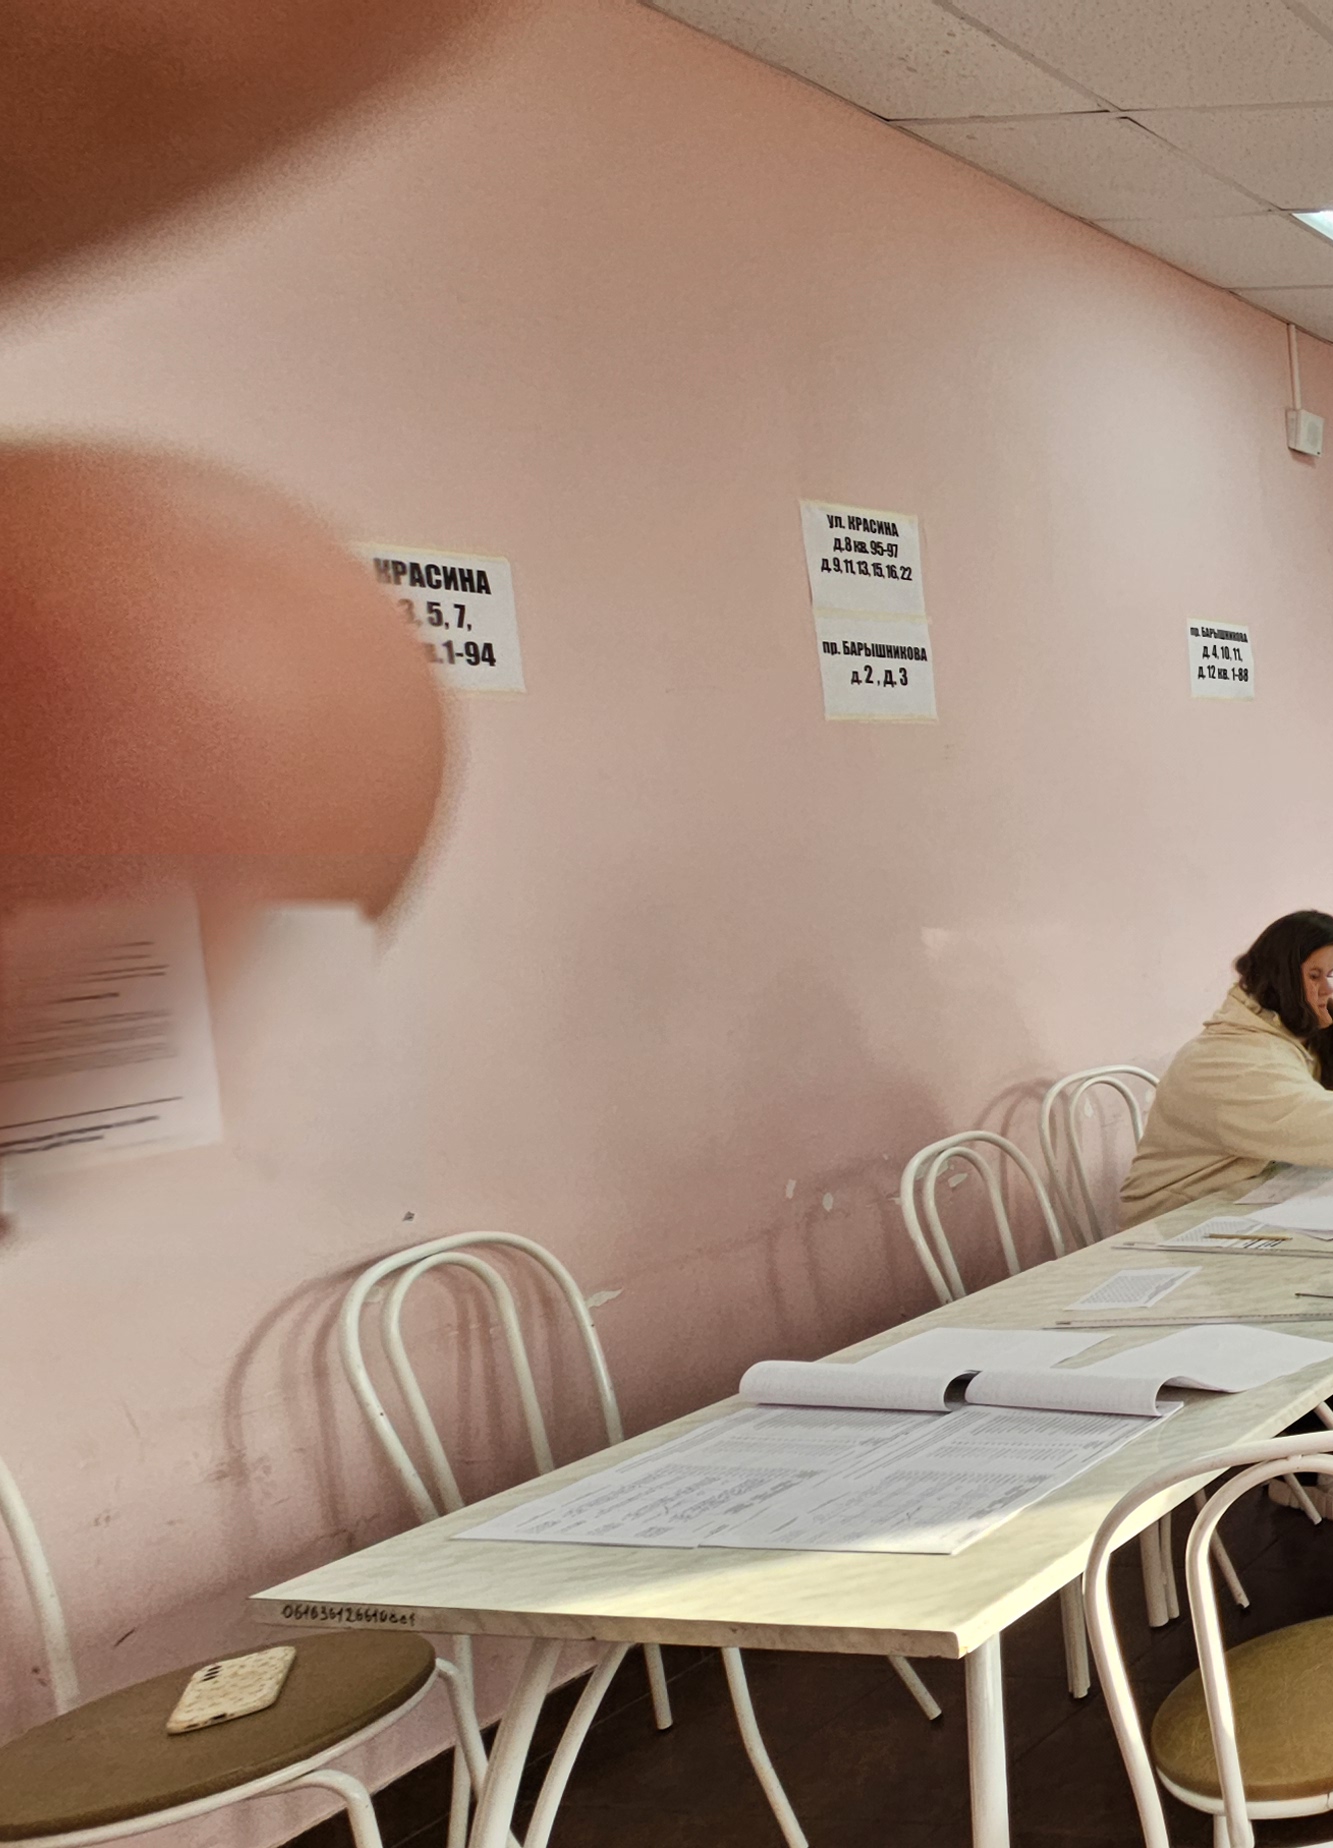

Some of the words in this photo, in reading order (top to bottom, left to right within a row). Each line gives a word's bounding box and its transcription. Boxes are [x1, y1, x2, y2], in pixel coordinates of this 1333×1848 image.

[826, 513, 846, 529] ул.
[847, 515, 899, 538] КРАСИНА
[870, 540, 898, 558] 95-97
[900, 566, 913, 581] 22
[426, 600, 450, 630] 5,
[453, 603, 472, 632] 7,
[822, 641, 841, 656] пр.
[842, 640, 928, 662] БАРЫШНИКОВА
[899, 667, 908, 686] 3
